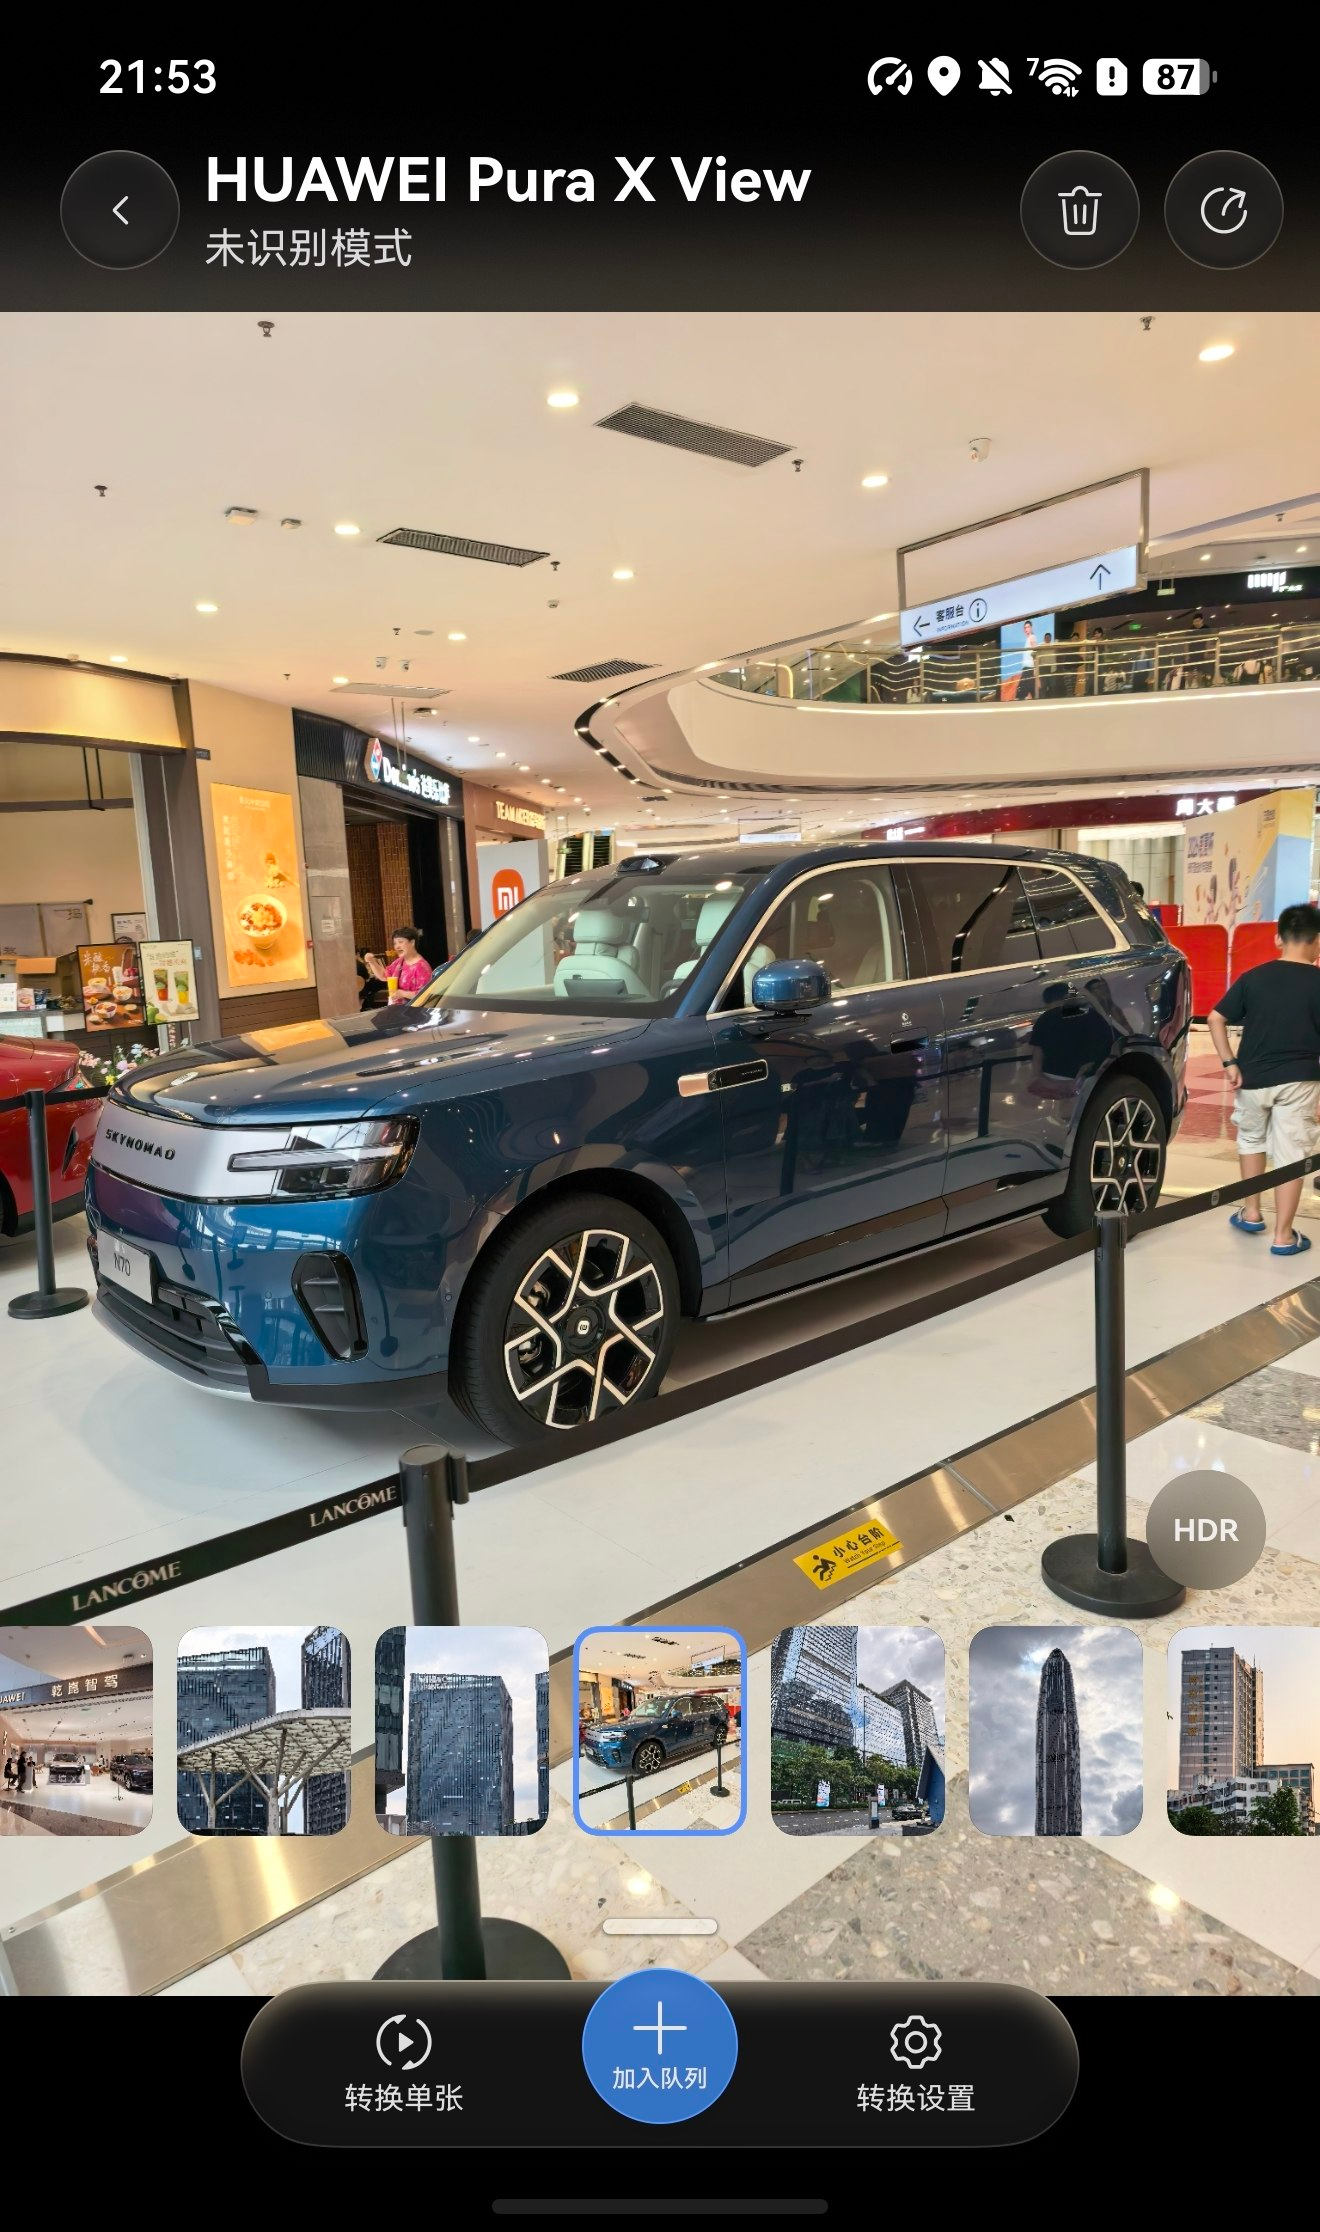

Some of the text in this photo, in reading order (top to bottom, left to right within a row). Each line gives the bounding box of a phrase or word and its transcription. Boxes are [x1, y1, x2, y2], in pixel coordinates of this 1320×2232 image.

[936, 604, 965, 623] 客服台
[105, 1128, 176, 1161] SKYNOMAD
[113, 1252, 132, 1277] N70
[308, 1484, 398, 1528] LANCÔME
[833, 1527, 885, 1558] 小心台阶
[843, 1552, 862, 1564] Watch
[71, 1560, 183, 1612] LANCÔME
[50, 1674, 119, 1698] 乾崑智驾
